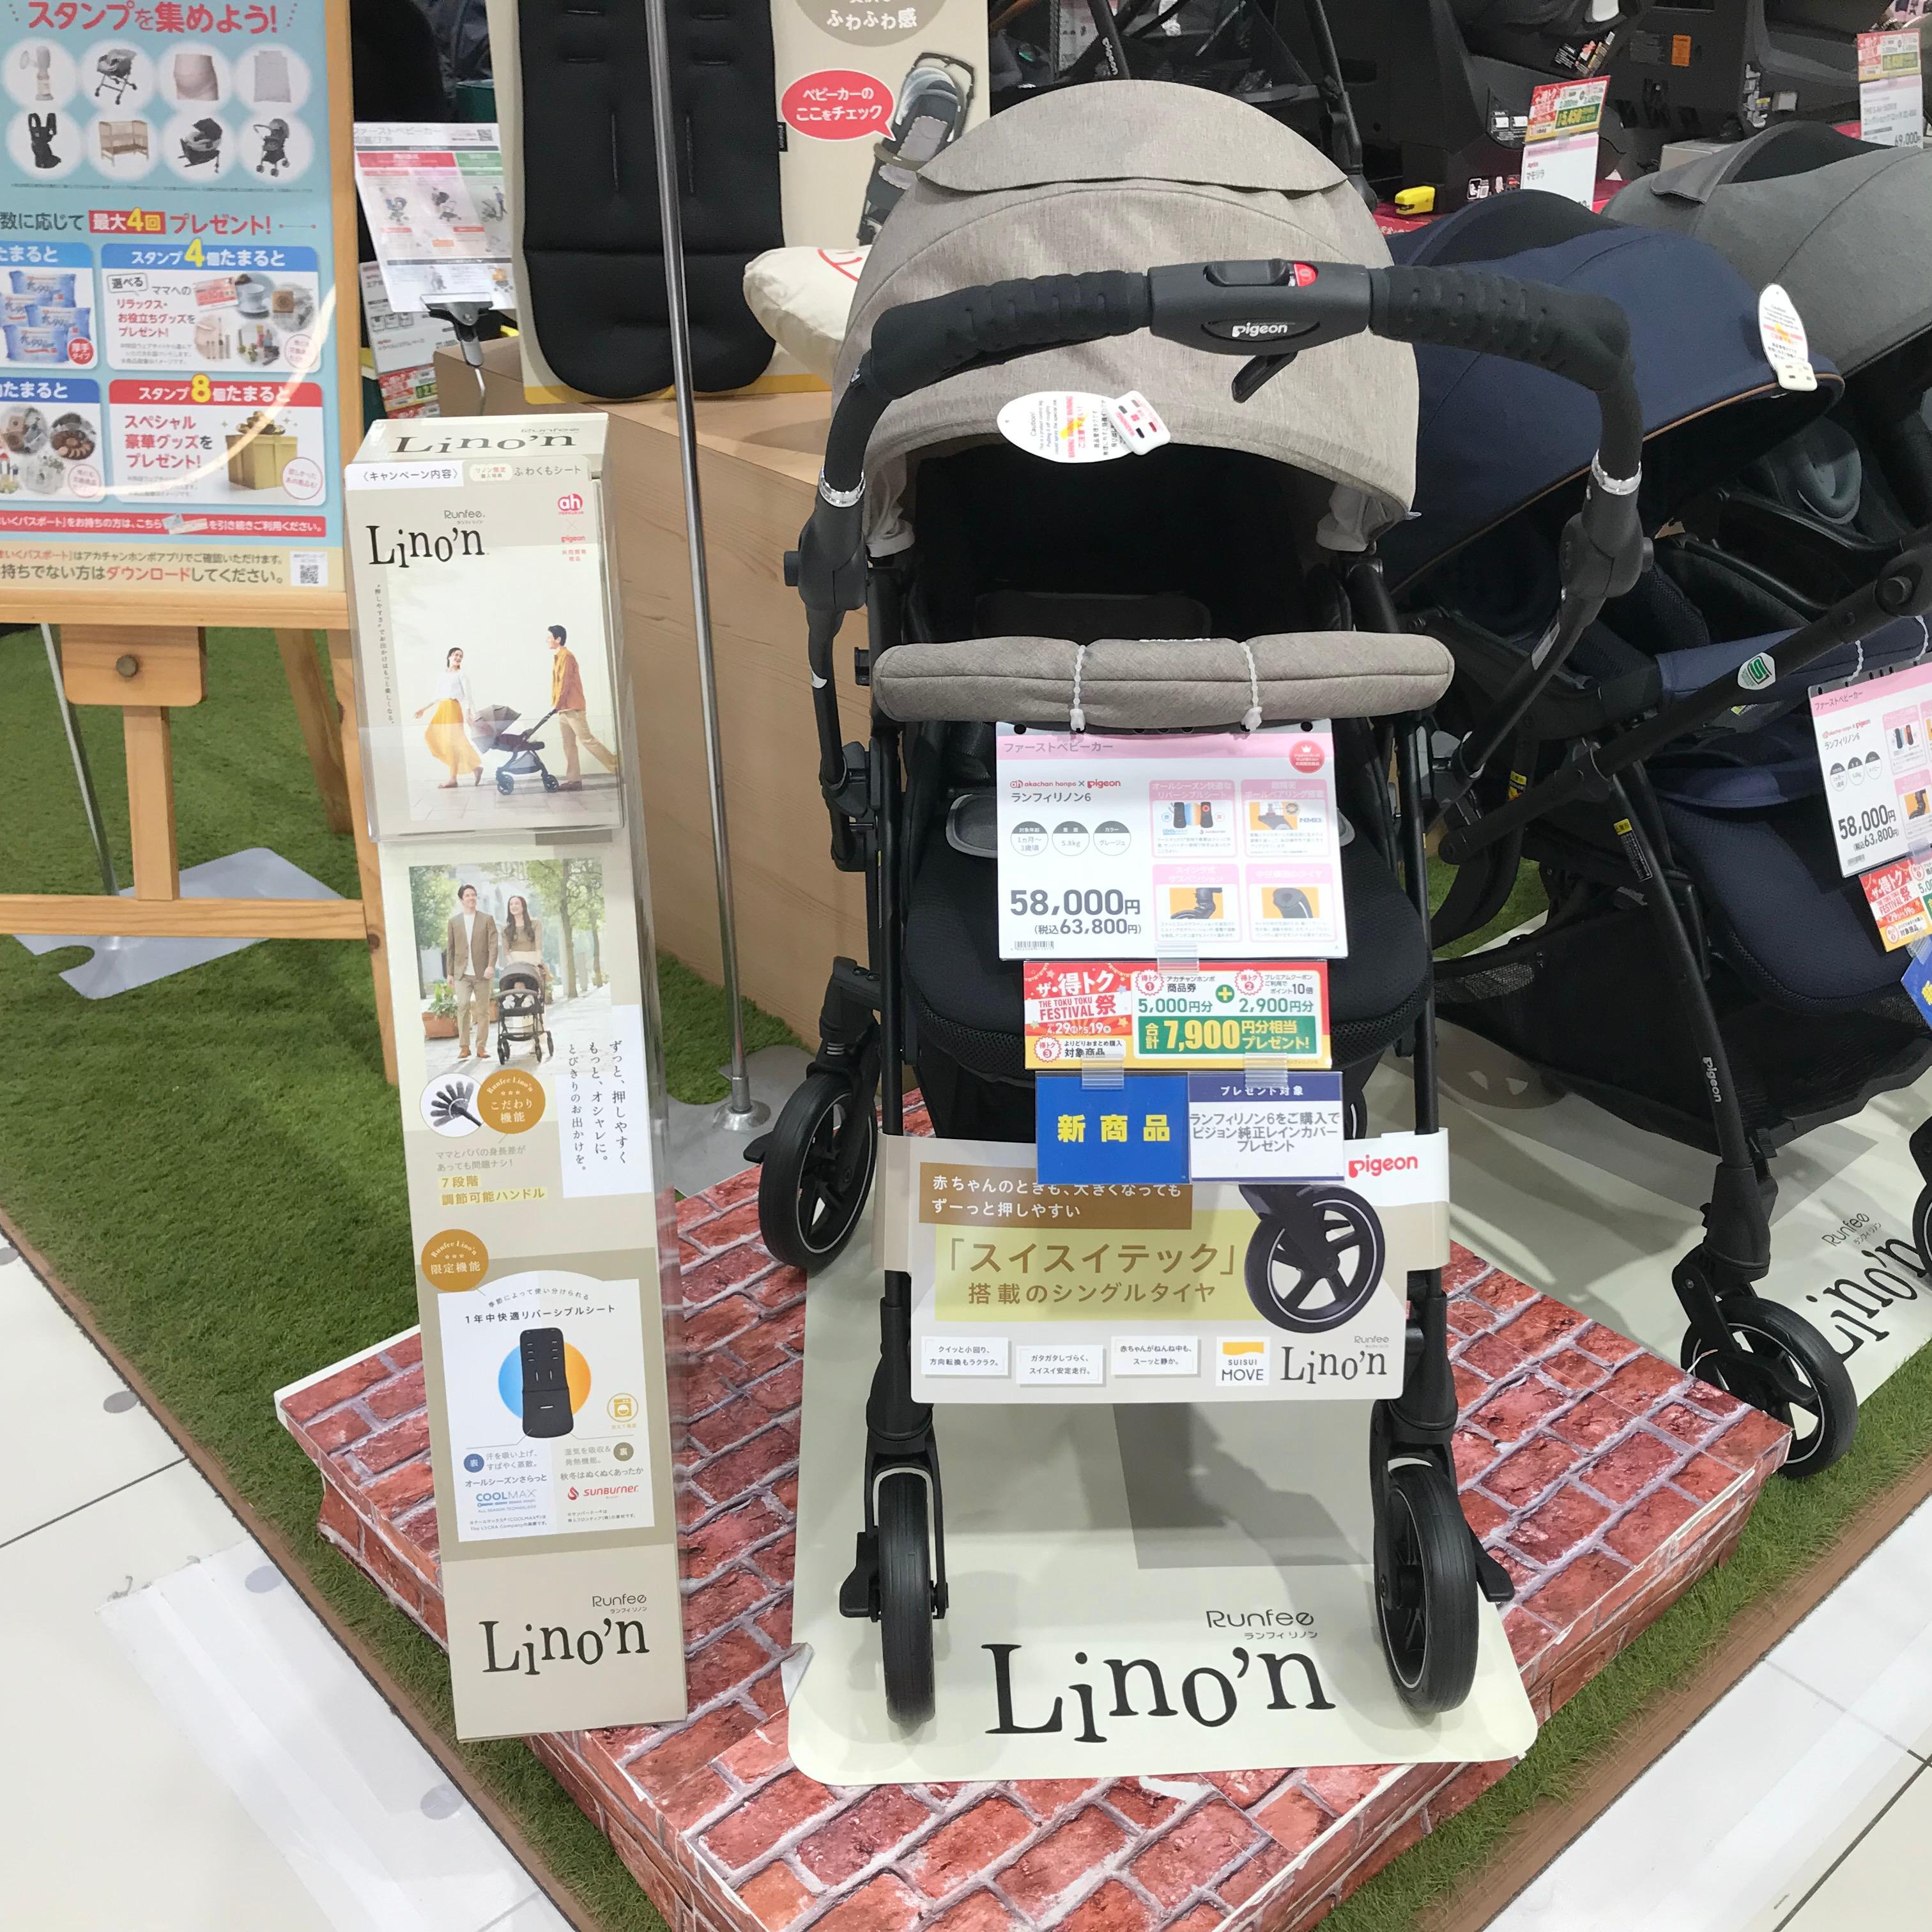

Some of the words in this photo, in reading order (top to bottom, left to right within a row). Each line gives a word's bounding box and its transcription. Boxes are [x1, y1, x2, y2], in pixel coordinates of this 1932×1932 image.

[826, 7, 917, 31] ふわふわ感
[802, 87, 875, 101] ベビーカーの
[796, 105, 882, 121] ここをチェック
[0, 211, 84, 231] 数に応じて
[92, 207, 162, 232] 最大4回
[171, 215, 271, 234] プレゼント!
[131, 238, 286, 267] スタンプ4個たまると
[112, 277, 143, 289] 選べる
[152, 286, 192, 295] ママへの
[118, 313, 195, 324] お役立ちグッズを
[1232, 322, 1288, 337] pigeon
[139, 374, 291, 403] スタンプ8個たまると
[125, 415, 196, 429] スペシャル
[125, 435, 213, 450] 豪華グッズを
[388, 434, 578, 454] Lino'n
[127, 455, 203, 468] プレゼント!
[514, 464, 582, 477] ふわくもシート
[558, 494, 581, 511] ah
[444, 509, 483, 519] Runfee
[365, 525, 486, 569] Lino'n
[1004, 741, 1113, 753] ファーストベビーカー
[1825, 733, 1860, 750] ランフィリノン6
[1055, 781, 1077, 789] honpo
[1087, 779, 1121, 789] pigeon
[1011, 792, 1092, 802] ランフィリノン6
[1838, 805, 1896, 839] 58,000円
[1010, 889, 1141, 916] 58,000円
[1879, 896, 1904, 916] FESTIVAL
[1034, 918, 1142, 935] (税込63,800円)
[1036, 970, 1114, 997] ザ・得トク
[1167, 983, 1197, 993] 商品券
[1270, 983, 1314, 995] ポイント10倍
[1039, 999, 1052, 1008] THE
[1054, 998, 1072, 1007] TOKU
[1039, 1005, 1094, 1021] FESTIVAL
[1096, 995, 1116, 1016] 祭
[1138, 998, 1213, 1013] 5,000円分
[1239, 998, 1314, 1013] 2,900円分
[1241, 1020, 1298, 1034] 円分相当
[1243, 1036, 1309, 1050] プレゼント!
[1064, 1048, 1105, 1058] 対象商品
[1703, 1057, 1722, 1103] pigeon
[1220, 1085, 1304, 1096] プレゼント対象
[491, 1098, 532, 1110] こだわり
[568, 1043, 586, 1170] とびきりのお出かけを。
[588, 1041, 608, 1162] もっと、オシャレに。
[609, 1040, 627, 1164] ずっと、押しやすく
[500, 1112, 525, 1123] 機能
[1189, 1112, 1341, 1126] ランフィリノン6をご購入で
[1057, 1114, 1171, 1144] 新商品
[1193, 1126, 1338, 1140] ピジョン純正レインカバー
[436, 1145, 526, 1160] ママとパパの身長差が
[1237, 1139, 1295, 1153] プレゼント
[1348, 1153, 1419, 1178] pigeon
[441, 1175, 479, 1188] 7段階
[441, 1188, 545, 1206] 調節可能ハンドル
[931, 1199, 1080, 1218] ずーっと押しやすい
[1821, 1213, 1870, 1246] Runfee
[951, 1237, 1235, 1277] 「スイスイテック」
[431, 1261, 480, 1275] 限定機能
[488, 1288, 589, 1308] 季節によって使い分けられる
[968, 1282, 1215, 1305] 搭載のシングルタイヤ
[465, 1304, 615, 1324] 1年中快適リバーシブルシート
[938, 1346, 990, 1354] クイッと小回り、
[1120, 1345, 1192, 1353] 赤ちゃんがねんね中も、
[930, 1358, 999, 1367] 方向転換もラクラク。
[1031, 1354, 1089, 1363] ガタガタしづらく、
[1133, 1358, 1179, 1366] スーッと静か。
[1280, 1346, 1388, 1384] Lino'n
[1029, 1367, 1091, 1375] スイスイ安定走行。
[1222, 1368, 1264, 1381] MOVE
[486, 1450, 537, 1461] 汗を吸い上げ、
[465, 1474, 548, 1488] オールシーズンさらっと
[560, 1467, 644, 1481] 秋冬はぬくぬくあったか
[592, 1593, 647, 1607] Runfee
[1206, 1609, 1315, 1629] Runfee
[479, 1618, 650, 1676] Lino'n
[981, 1643, 1337, 1744] Lino'n
